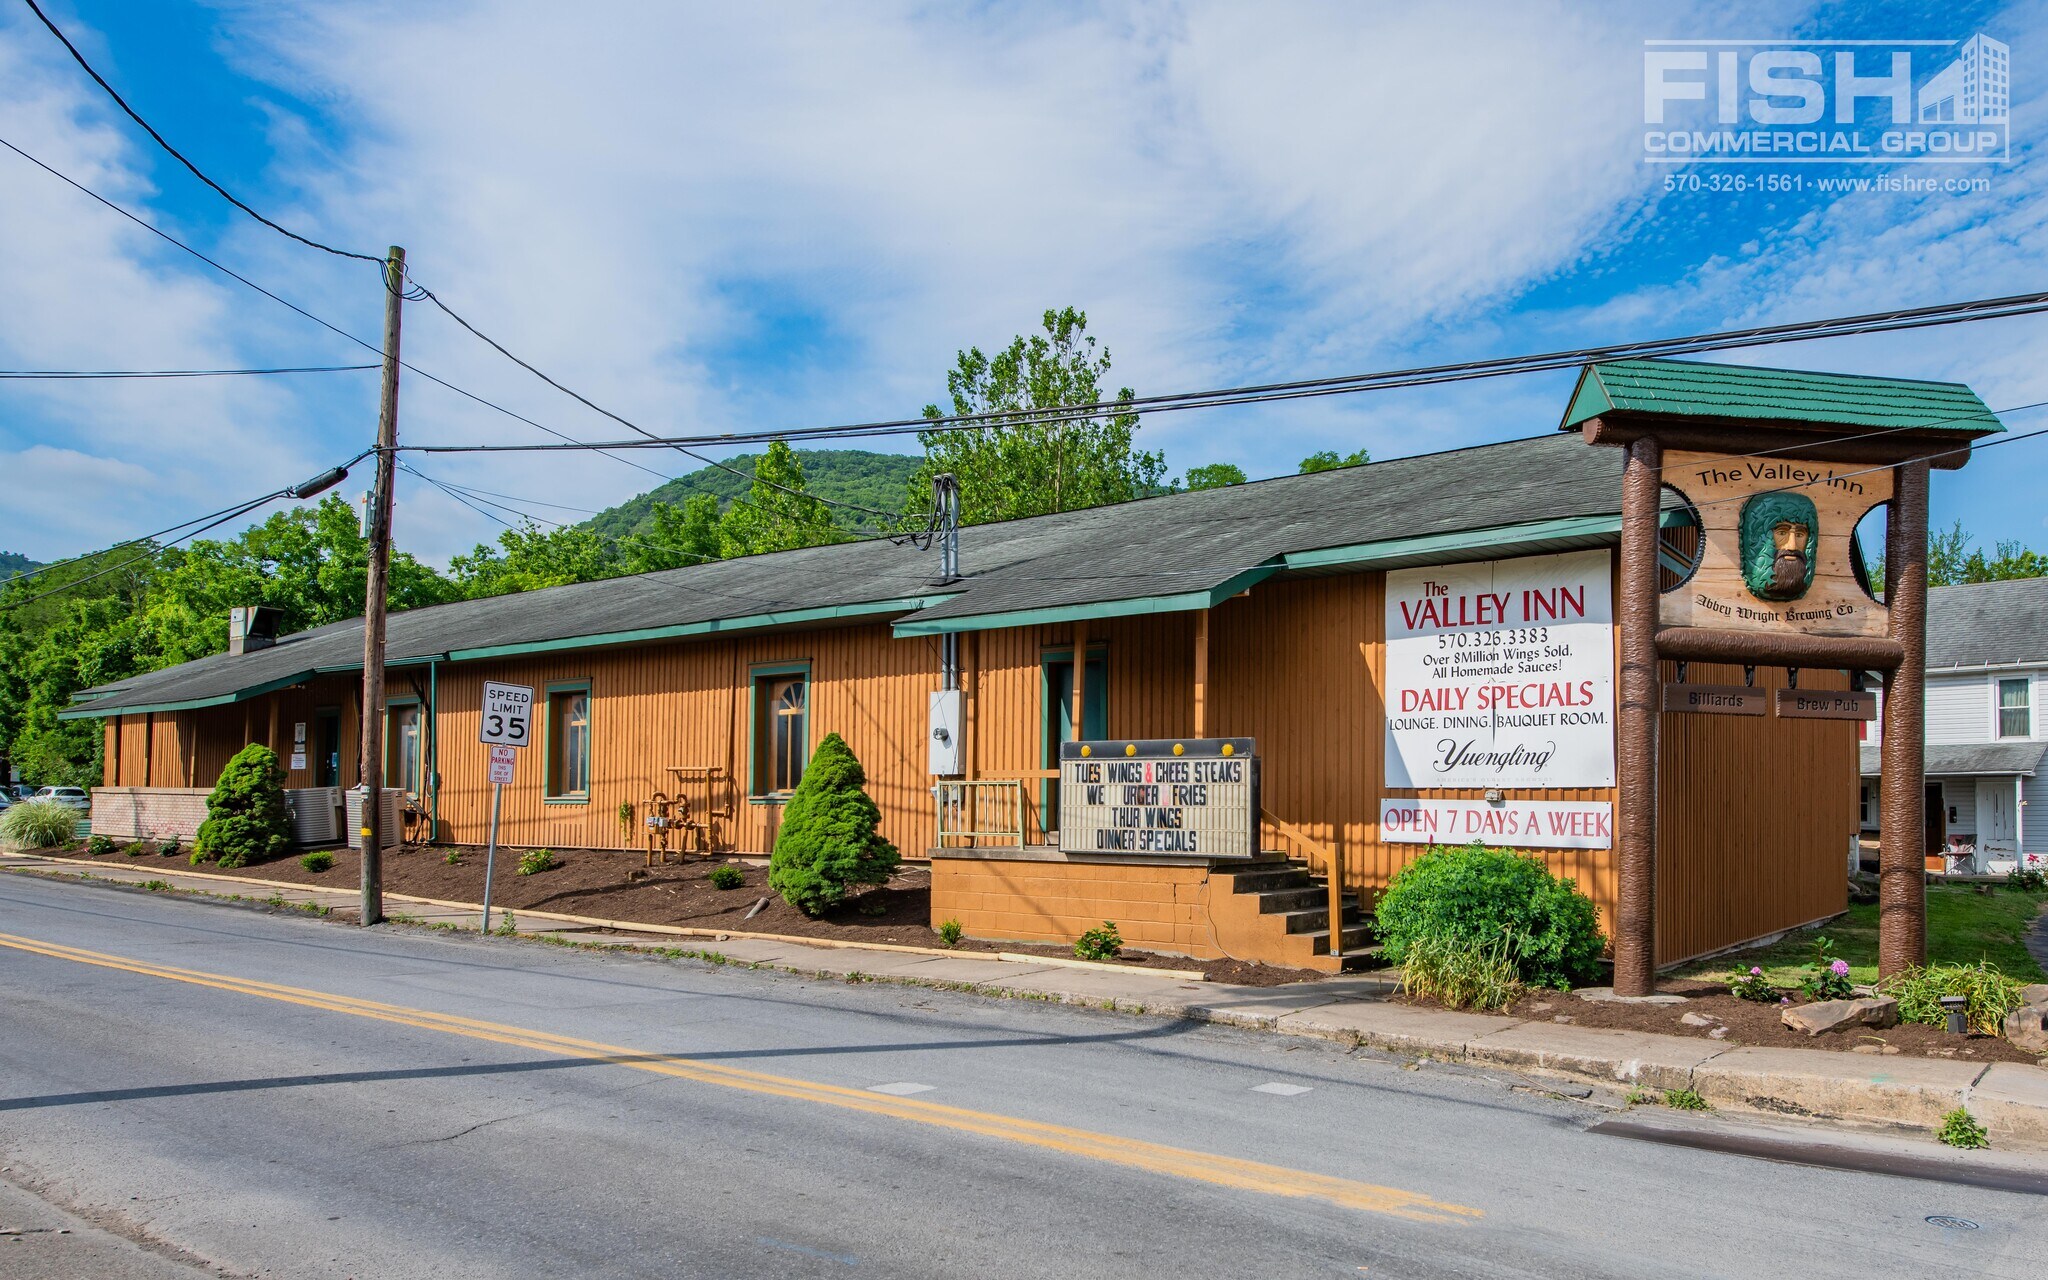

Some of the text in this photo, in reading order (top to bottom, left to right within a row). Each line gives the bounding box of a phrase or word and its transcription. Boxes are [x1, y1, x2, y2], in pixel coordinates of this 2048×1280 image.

[1696, 463, 1864, 495] The Valley Inn
[1423, 581, 1449, 597] The
[1400, 585, 1585, 630] VALLEY INN
[1695, 594, 1857, 623] Abbey Wright Brewing Co.
[1438, 627, 1548, 649] 570.326.3383
[1423, 653, 1450, 667] Over
[1454, 651, 1500, 664] 8Million
[1504, 648, 1540, 662] Wings
[1432, 659, 1562, 679] All Homemade Sauces!
[489, 689, 529, 703] SPEED
[1401, 681, 1594, 713] DAILY SPECIALS
[1688, 691, 1744, 708] Billiards
[1797, 697, 1859, 713] Brew Pub
[492, 702, 523, 715] LIMIT
[486, 715, 525, 739] 35
[1389, 712, 1608, 731] LOUNGE. DINING. BAUQUET ROOM.
[490, 756, 514, 766] PARKING
[499, 749, 509, 757] NO
[1433, 738, 1556, 774] Yuengling
[1075, 761, 1241, 784] TUES WINGS & CHEES STEAKS
[1087, 785, 1104, 806] WE
[1123, 785, 1159, 806] URGER
[1172, 785, 1207, 806] FRIES
[1112, 807, 1181, 829] THUR WINGS
[1385, 808, 1611, 838] OPEN 7 DAYS A WEEK
[1097, 829, 1196, 852] DINNER SPECIALS
